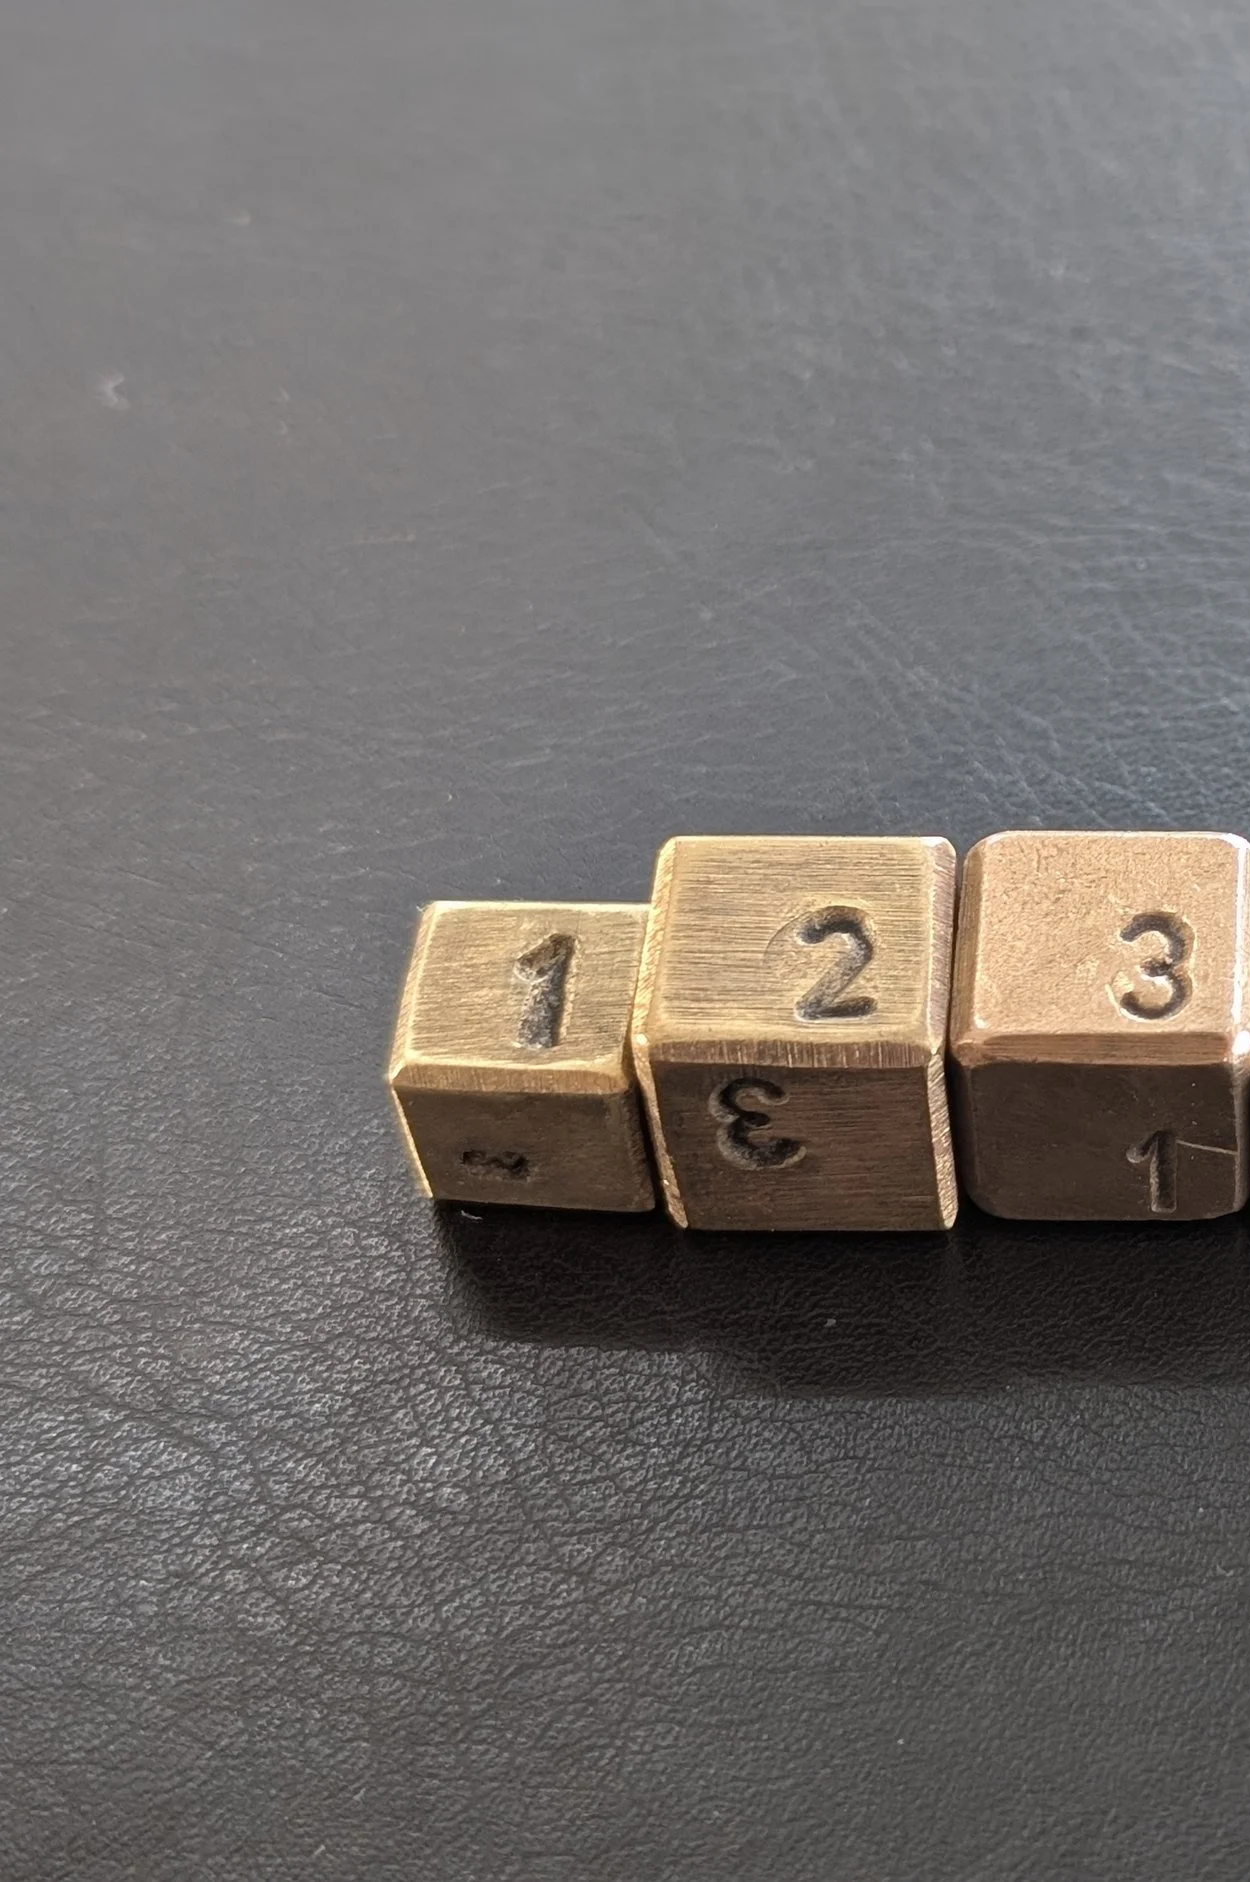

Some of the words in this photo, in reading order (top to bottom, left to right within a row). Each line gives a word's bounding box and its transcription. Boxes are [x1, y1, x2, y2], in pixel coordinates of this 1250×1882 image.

[514, 933, 577, 1049] 1
[795, 905, 878, 1020] 2
[1120, 911, 1194, 1020] 3
[1126, 1131, 1177, 1214] 1
